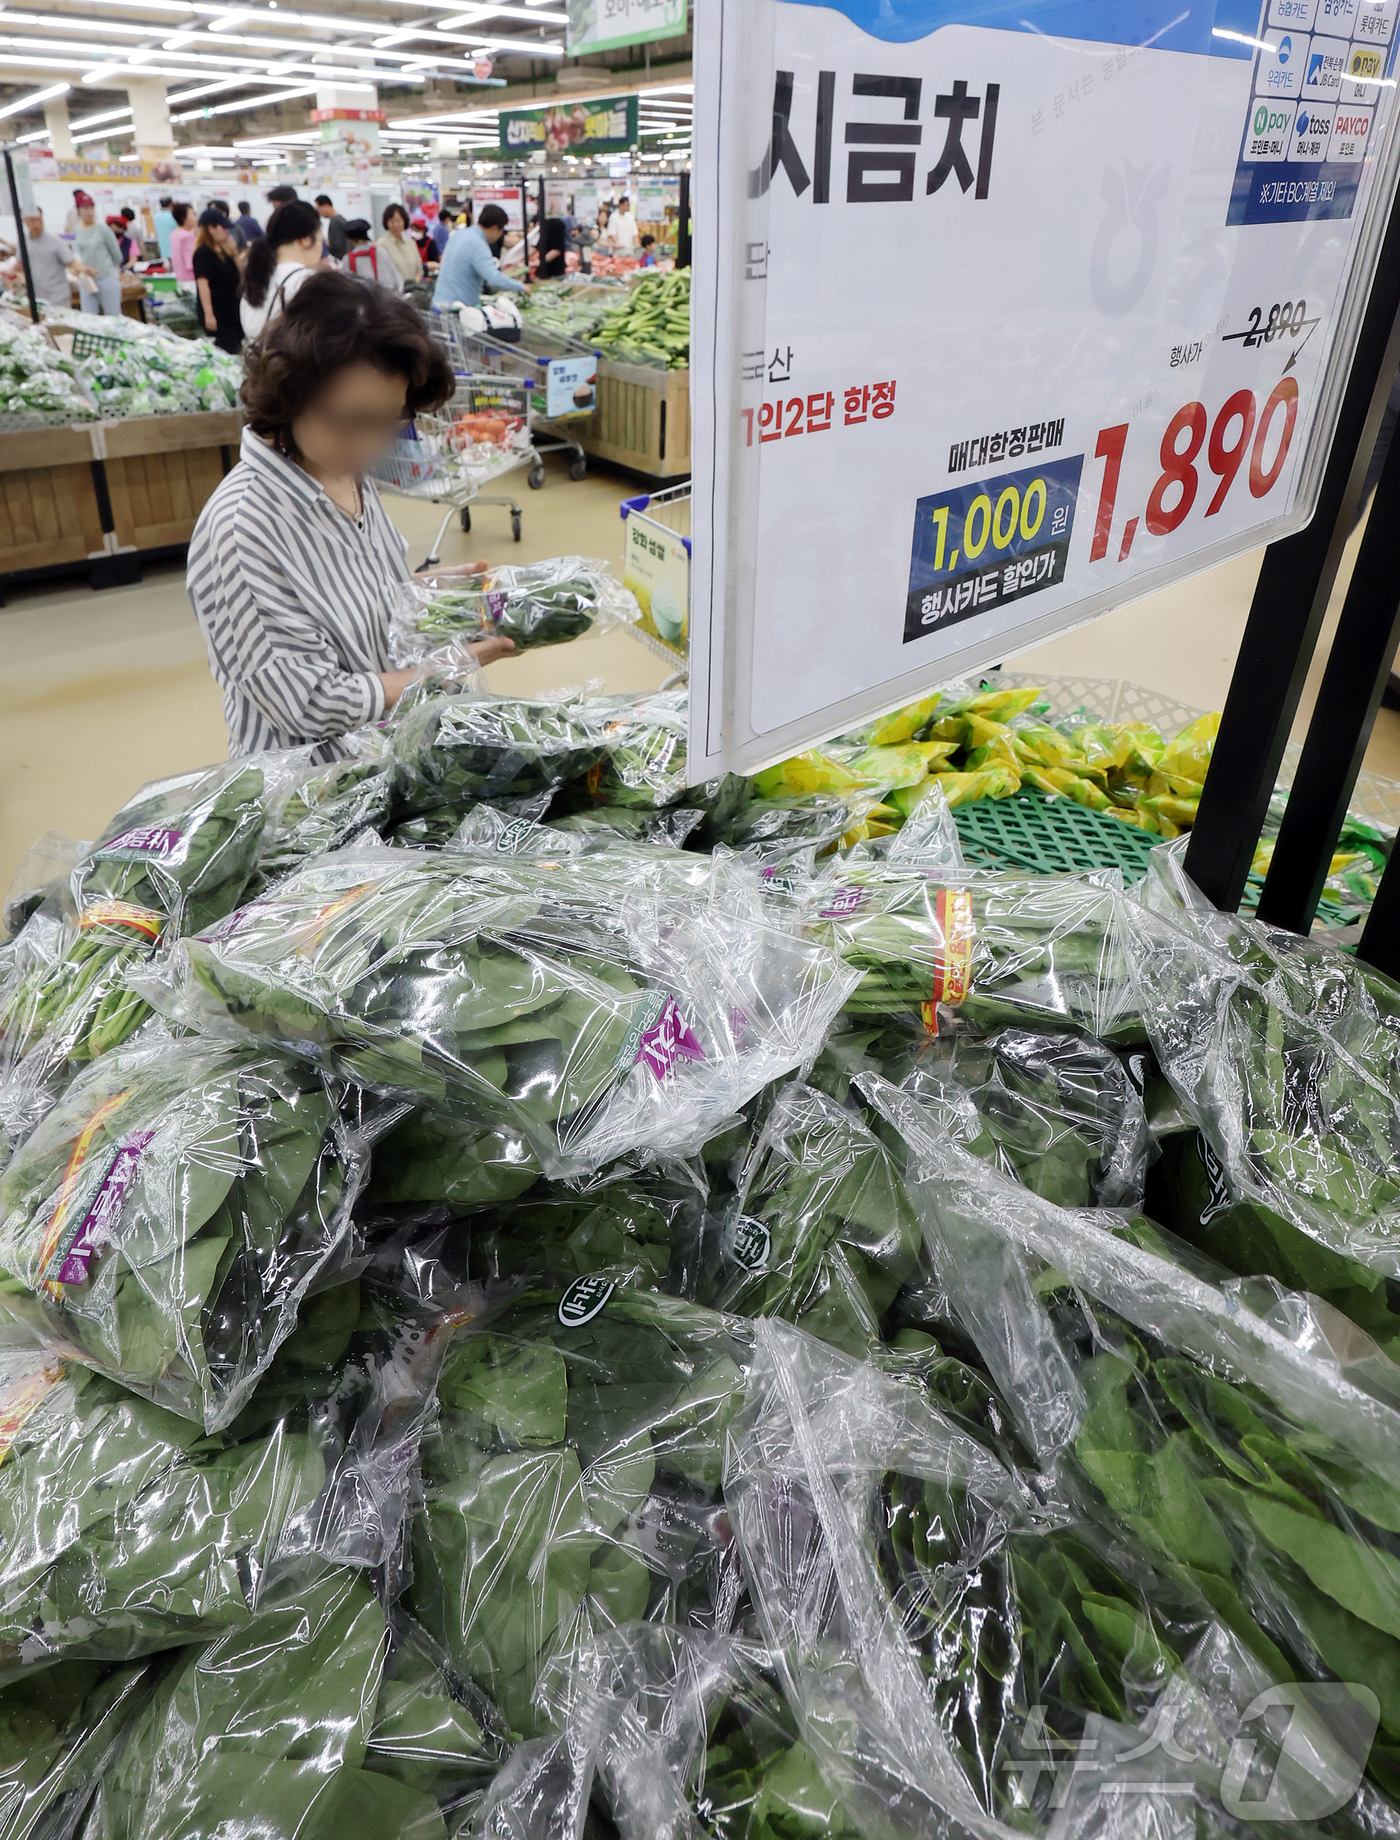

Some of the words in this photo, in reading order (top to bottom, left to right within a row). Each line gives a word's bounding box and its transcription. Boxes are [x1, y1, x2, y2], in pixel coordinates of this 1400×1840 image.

[1360, 15, 1389, 36] 롯데카드
[1323, 55, 1344, 72] 전북은행
[1266, 69, 1294, 89] 우리카드
[1319, 73, 1328, 87] JB
[1327, 74, 1340, 88] Card
[1353, 83, 1366, 98] 머니
[1053, 74, 1095, 119] 문서는
[748, 70, 1000, 204] 시금치
[1309, 113, 1330, 136] toss
[1335, 116, 1369, 136] PAYCO
[1338, 142, 1356, 155] 포인트
[1319, 180, 1336, 201] 제외
[1242, 299, 1307, 349] 2,890
[1169, 341, 1203, 368] 행사가
[741, 391, 835, 447] 1인2단
[843, 380, 897, 426] 한정
[947, 417, 1065, 474] 매대한정판매
[1089, 376, 1299, 563] 1,890
[932, 478, 1047, 572] 1,000
[1050, 505, 1069, 536] 원
[920, 571, 999, 625] 행사카드
[1002, 550, 1056, 596] 할인가
